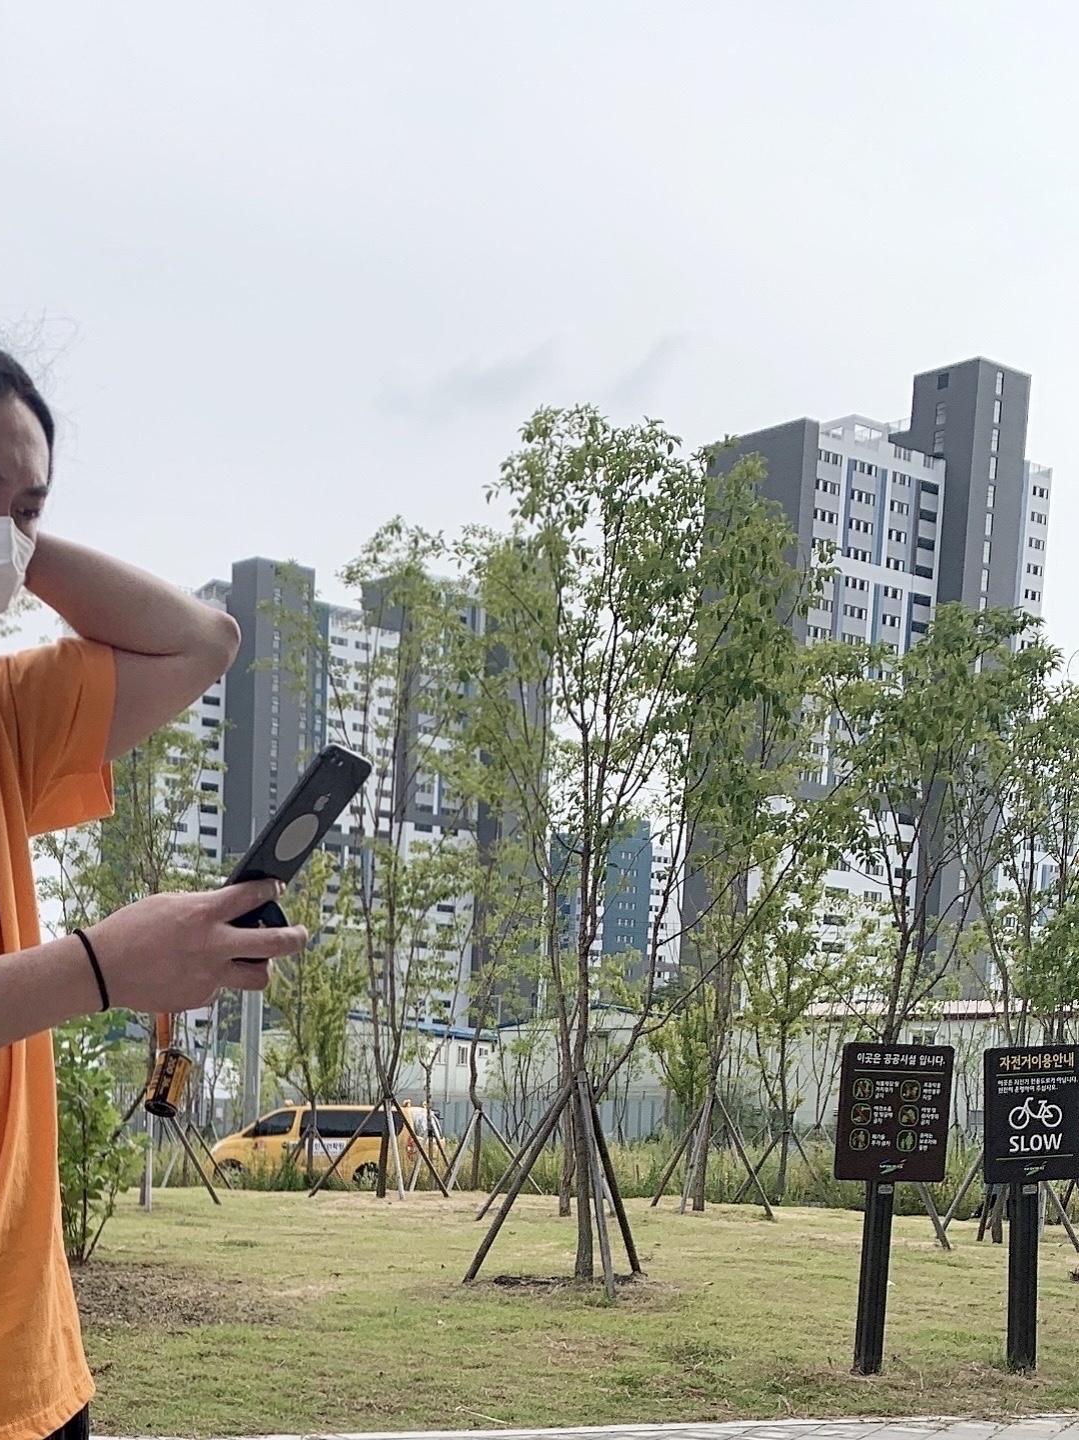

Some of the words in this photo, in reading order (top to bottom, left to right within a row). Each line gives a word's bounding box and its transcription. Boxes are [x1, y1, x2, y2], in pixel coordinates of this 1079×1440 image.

[856, 1052, 881, 1064] 이곳은
[883, 1053, 917, 1066] 공공시설
[999, 1051, 1075, 1071] 자전거이용안내
[1009, 1133, 1063, 1152] SLOW
